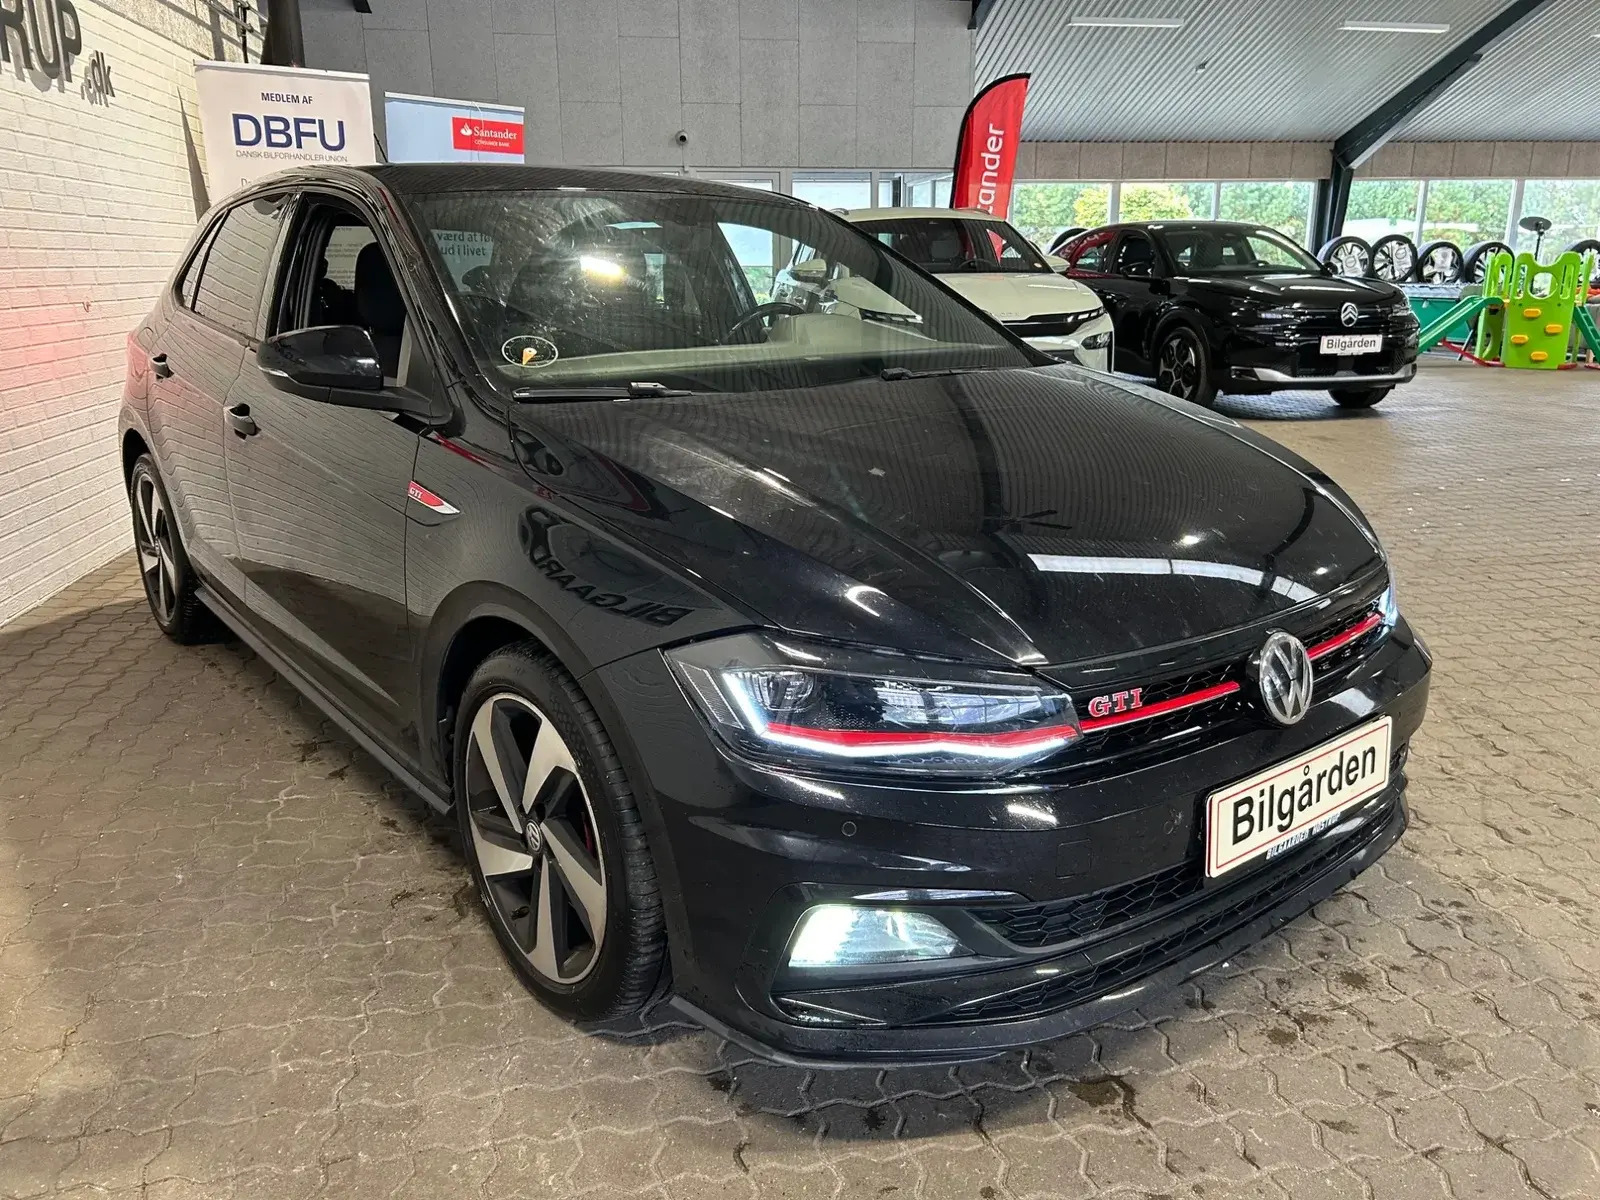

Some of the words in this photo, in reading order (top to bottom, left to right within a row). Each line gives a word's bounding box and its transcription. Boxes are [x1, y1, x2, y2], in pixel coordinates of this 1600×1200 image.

[261, 92, 300, 104] MEDLEM
[301, 96, 313, 104] AF
[232, 113, 346, 152] DBFU
[473, 126, 518, 140] Santander
[235, 150, 262, 159] DANSK
[263, 152, 324, 162] BILFORHANDLER
[324, 155, 348, 163] UNION
[437, 231, 464, 242] værd
[467, 233, 478, 243] at
[463, 244, 486, 256] livet
[409, 487, 423, 499] GTI
[1088, 688, 1142, 717] GTI
[1232, 746, 1376, 846] Bilgården
